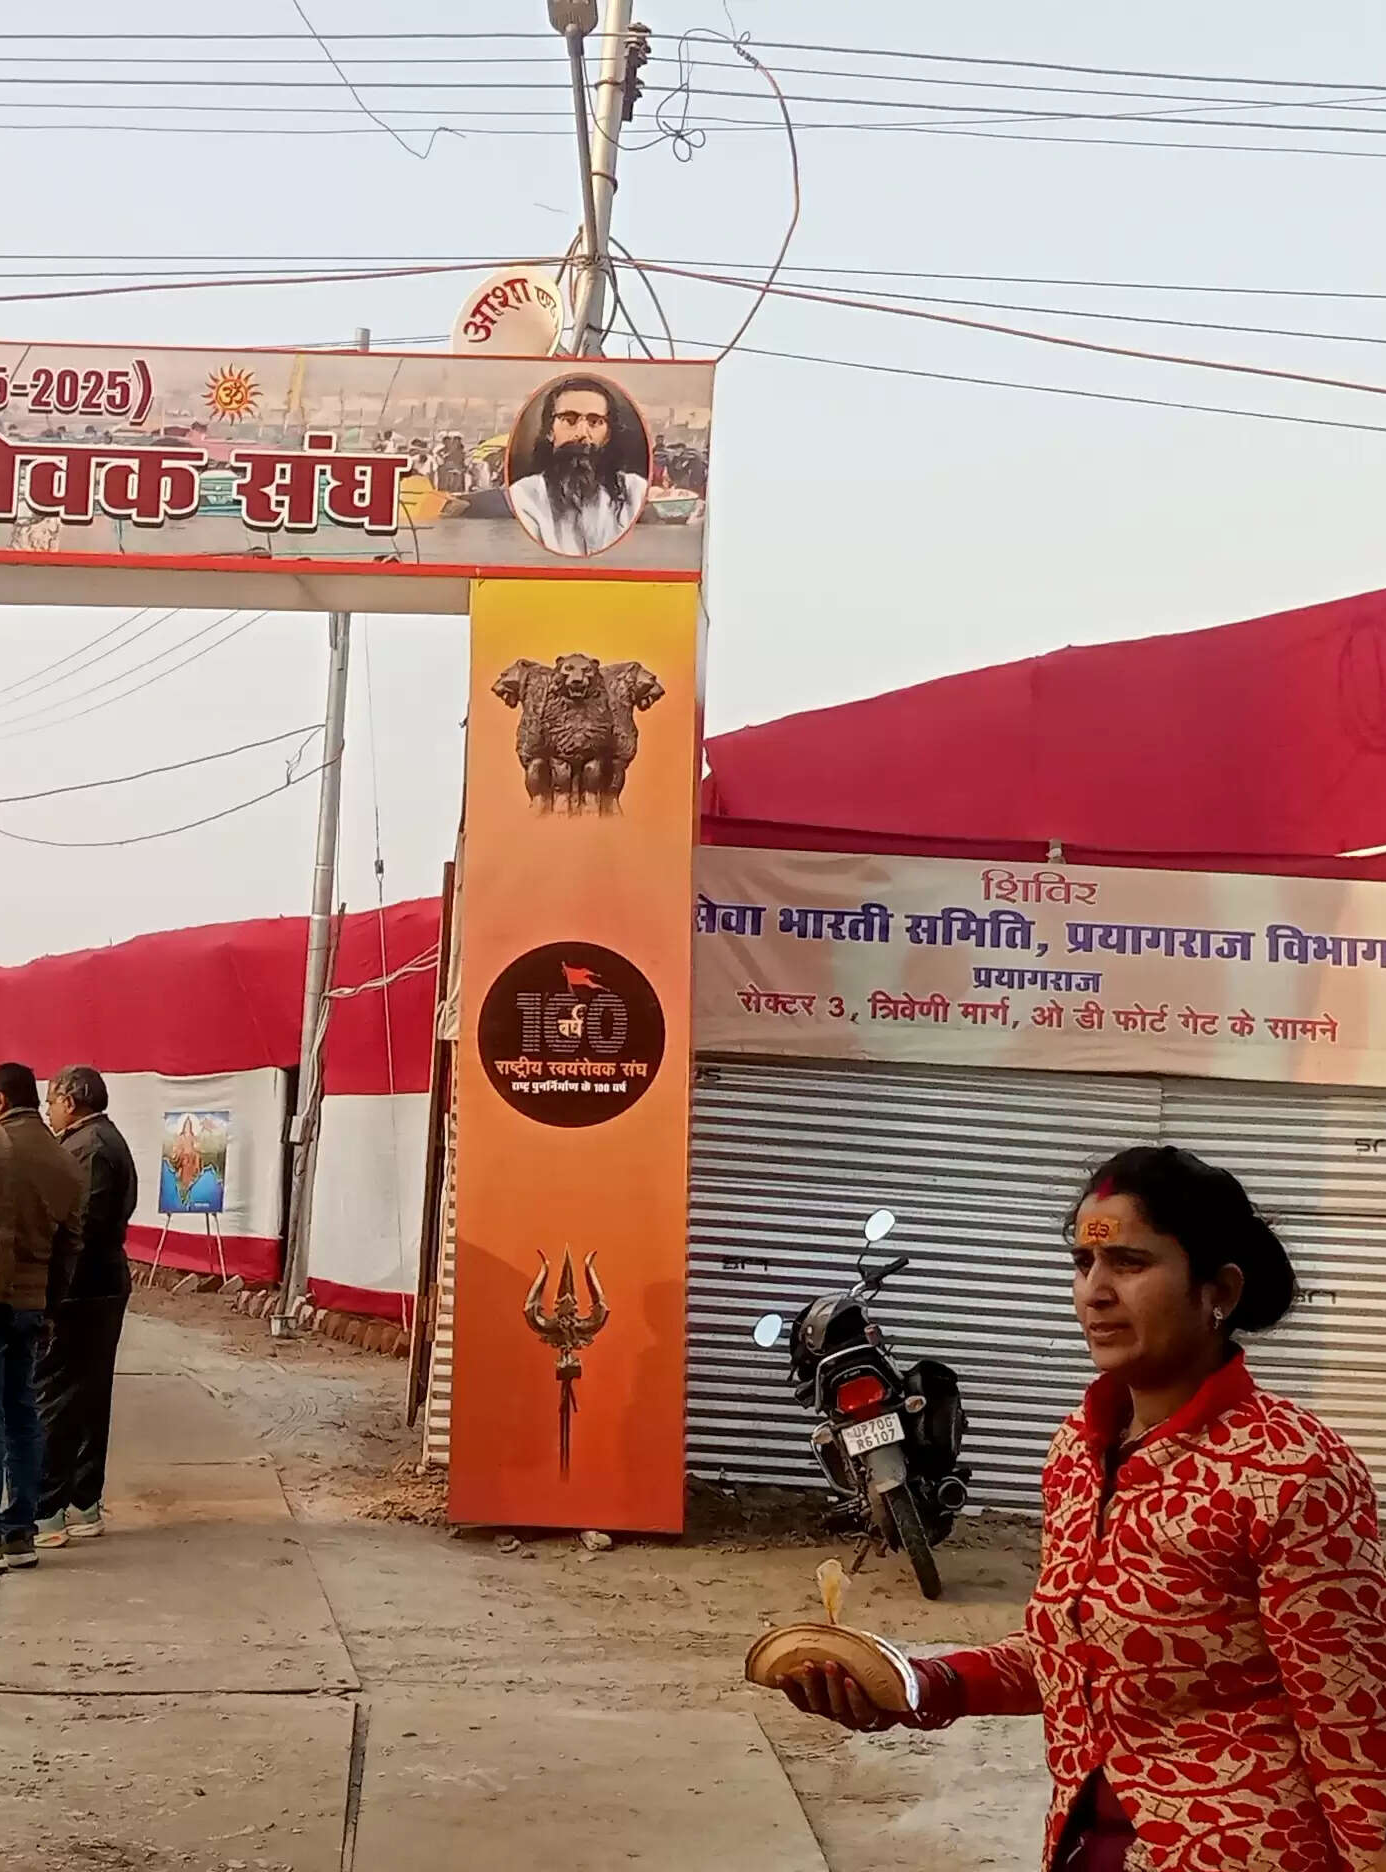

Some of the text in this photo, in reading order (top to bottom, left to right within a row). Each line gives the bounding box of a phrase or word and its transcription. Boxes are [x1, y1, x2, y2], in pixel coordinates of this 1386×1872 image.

[463, 278, 531, 343] आशा
[232, 431, 412, 531] संघ
[981, 868, 1098, 905] शिविर
[778, 903, 895, 943] भारती
[905, 907, 1050, 958] समिति,
[1065, 922, 1256, 962] प्रयागराज
[972, 966, 1103, 994] प्रयागराज
[558, 1004, 587, 1038] वर्ष
[738, 985, 1340, 1043] सेक्टर 3, त्रिवेणी मार्ग, ओ डी फोर्ट गेट के सामने
[494, 1056, 649, 1079] राष्ट्रीय स्वयंसेवक संघ
